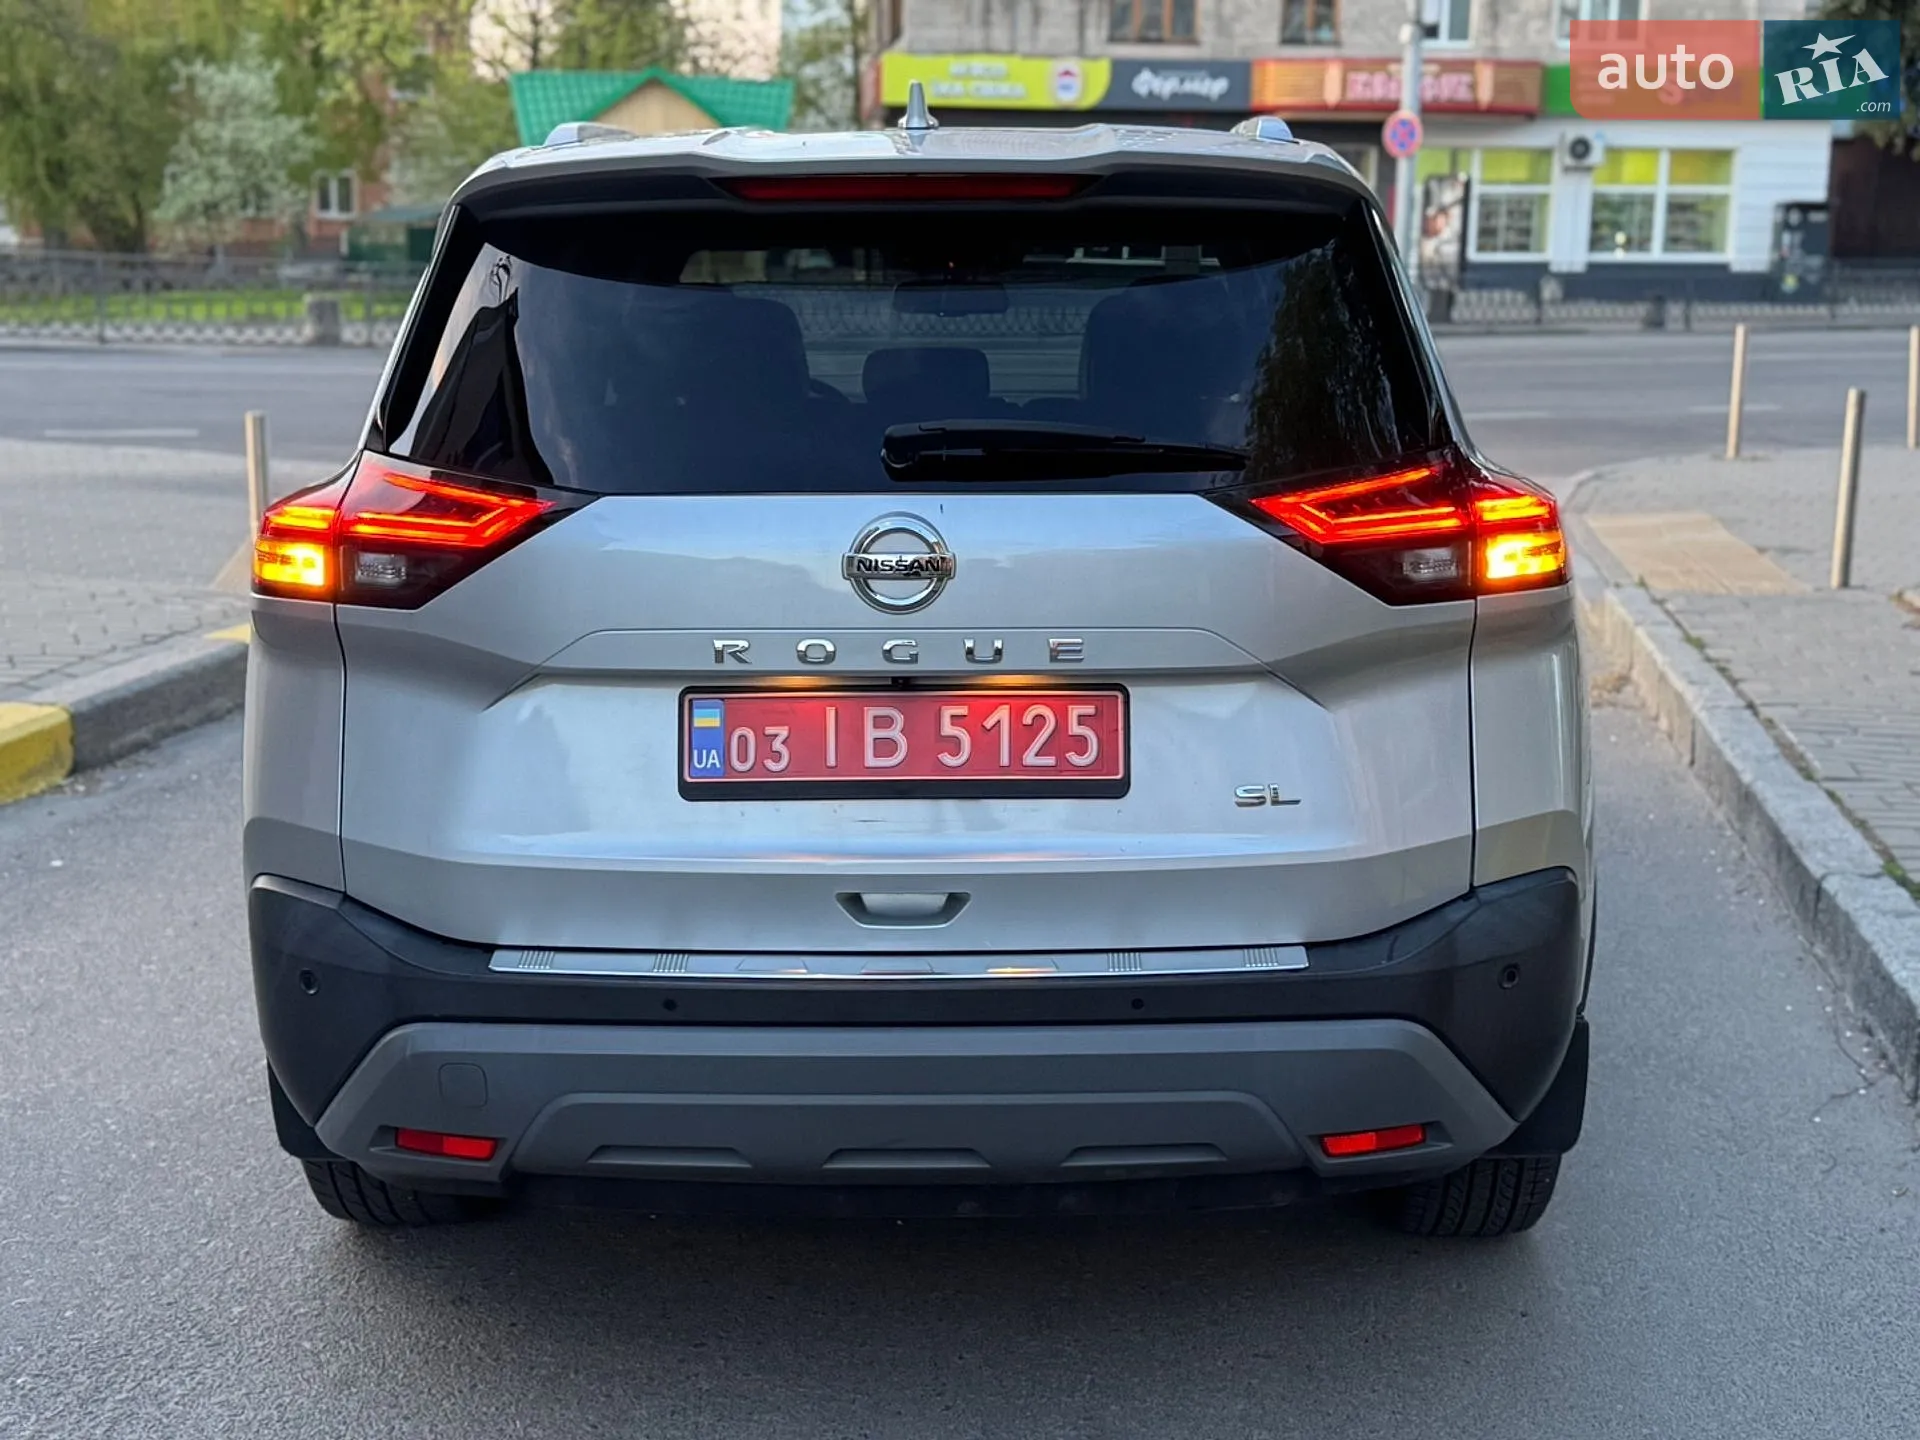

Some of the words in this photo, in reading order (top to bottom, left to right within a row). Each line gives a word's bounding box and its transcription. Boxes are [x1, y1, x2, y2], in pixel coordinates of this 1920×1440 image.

[856, 557, 941, 573] NISSAN
[712, 637, 1085, 665] ROGUE
[729, 726, 791, 773] 03
[936, 703, 1100, 769] 5125
[692, 749, 721, 769] UA
[1234, 783, 1302, 808] SL
